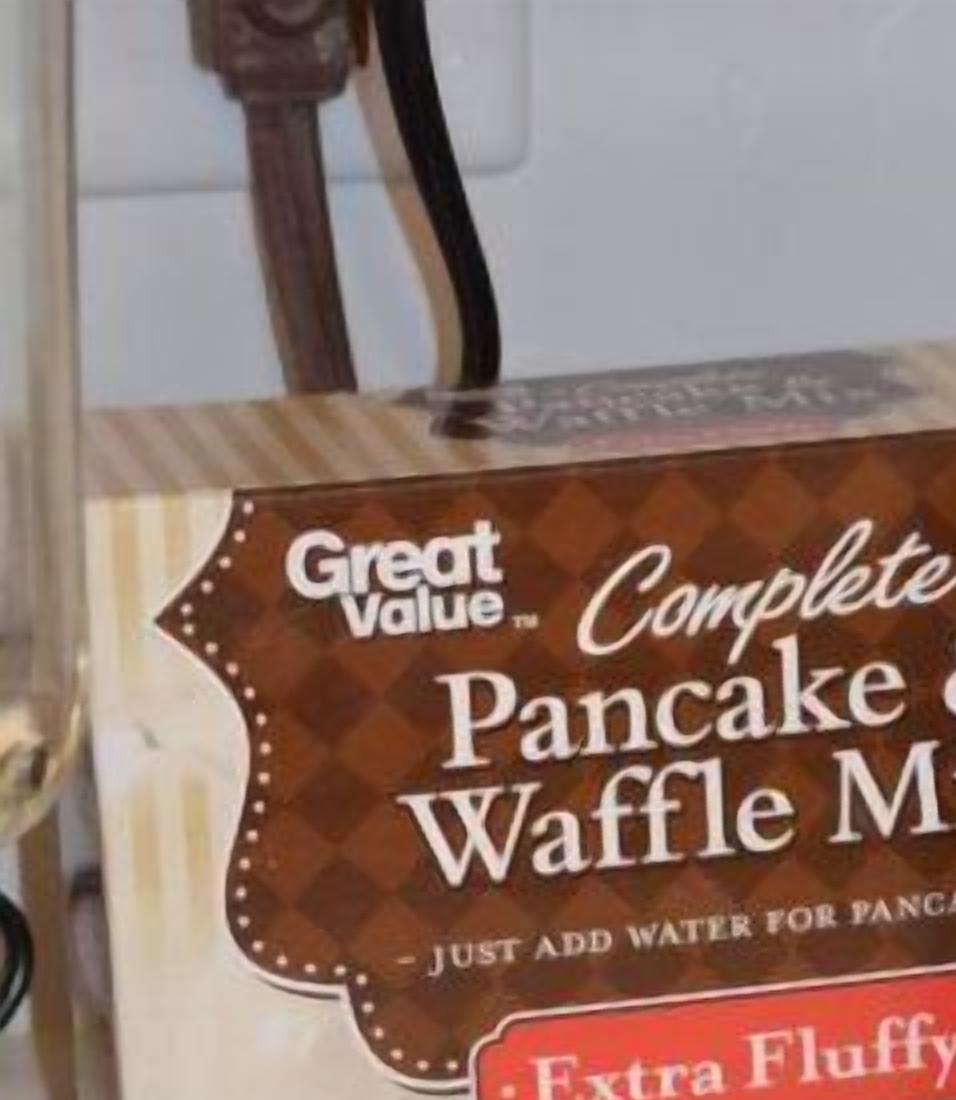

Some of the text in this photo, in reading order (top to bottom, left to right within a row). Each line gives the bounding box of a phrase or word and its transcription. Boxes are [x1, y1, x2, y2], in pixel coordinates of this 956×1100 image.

[285, 520, 504, 600] Great
[342, 588, 505, 639] Value
[435, 636, 905, 770] Pancake
[398, 757, 796, 889] Waffle
[428, 939, 521, 977] JUST
[535, 929, 613, 958] ADD
[628, 915, 754, 949] WATER
[767, 904, 837, 934] FOR
